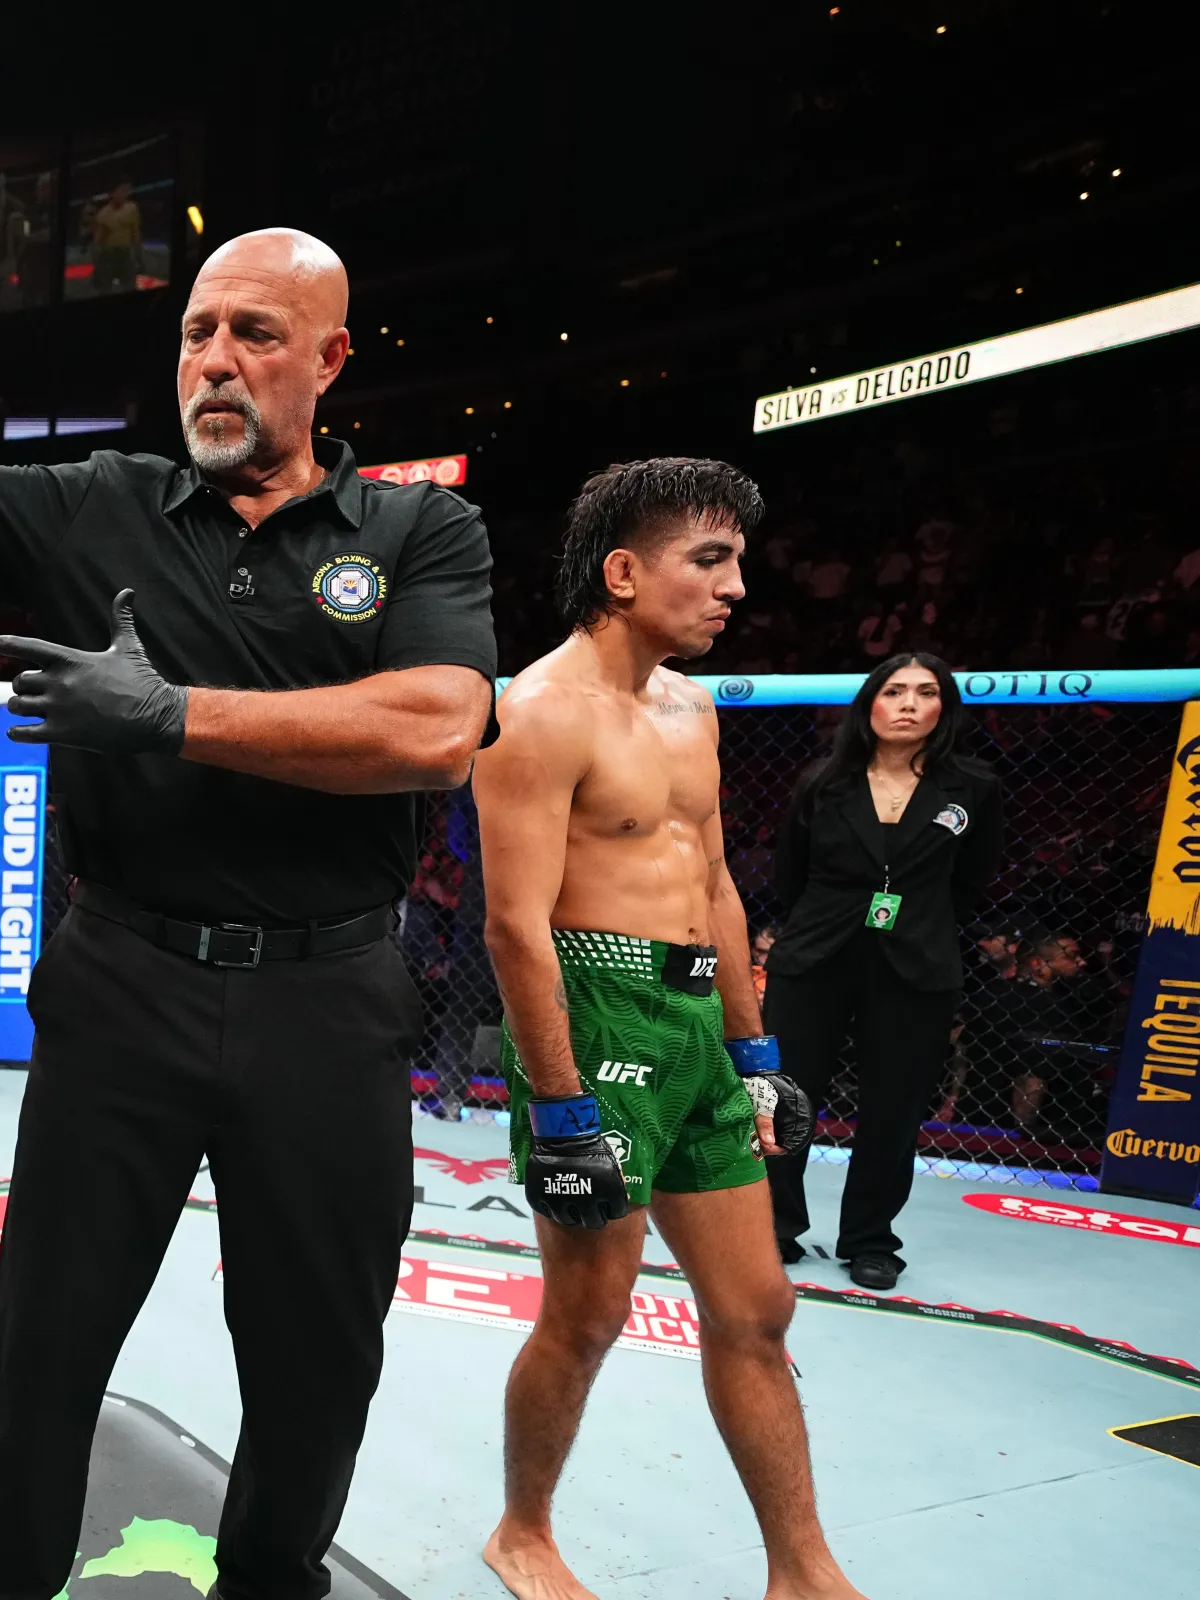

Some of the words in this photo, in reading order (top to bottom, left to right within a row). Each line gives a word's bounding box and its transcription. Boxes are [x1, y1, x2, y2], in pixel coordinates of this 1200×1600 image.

[761, 389, 822, 426] SILVA
[855, 350, 971, 404] DELGADO
[312, 562, 334, 594] ARIZONA
[335, 555, 371, 566] BOXING
[372, 566, 380, 574] &
[377, 575, 387, 599] MMA
[321, 604, 377, 621] COMMISSION
[2, 774, 38, 867] BUD
[596, 1060, 654, 1087] UFC
[1106, 1128, 1200, 1165] Cuervo
[544, 1177, 592, 1195] NOCHE
[554, 1173, 578, 1182] UFC
[999, 1207, 1103, 1231] wireless
